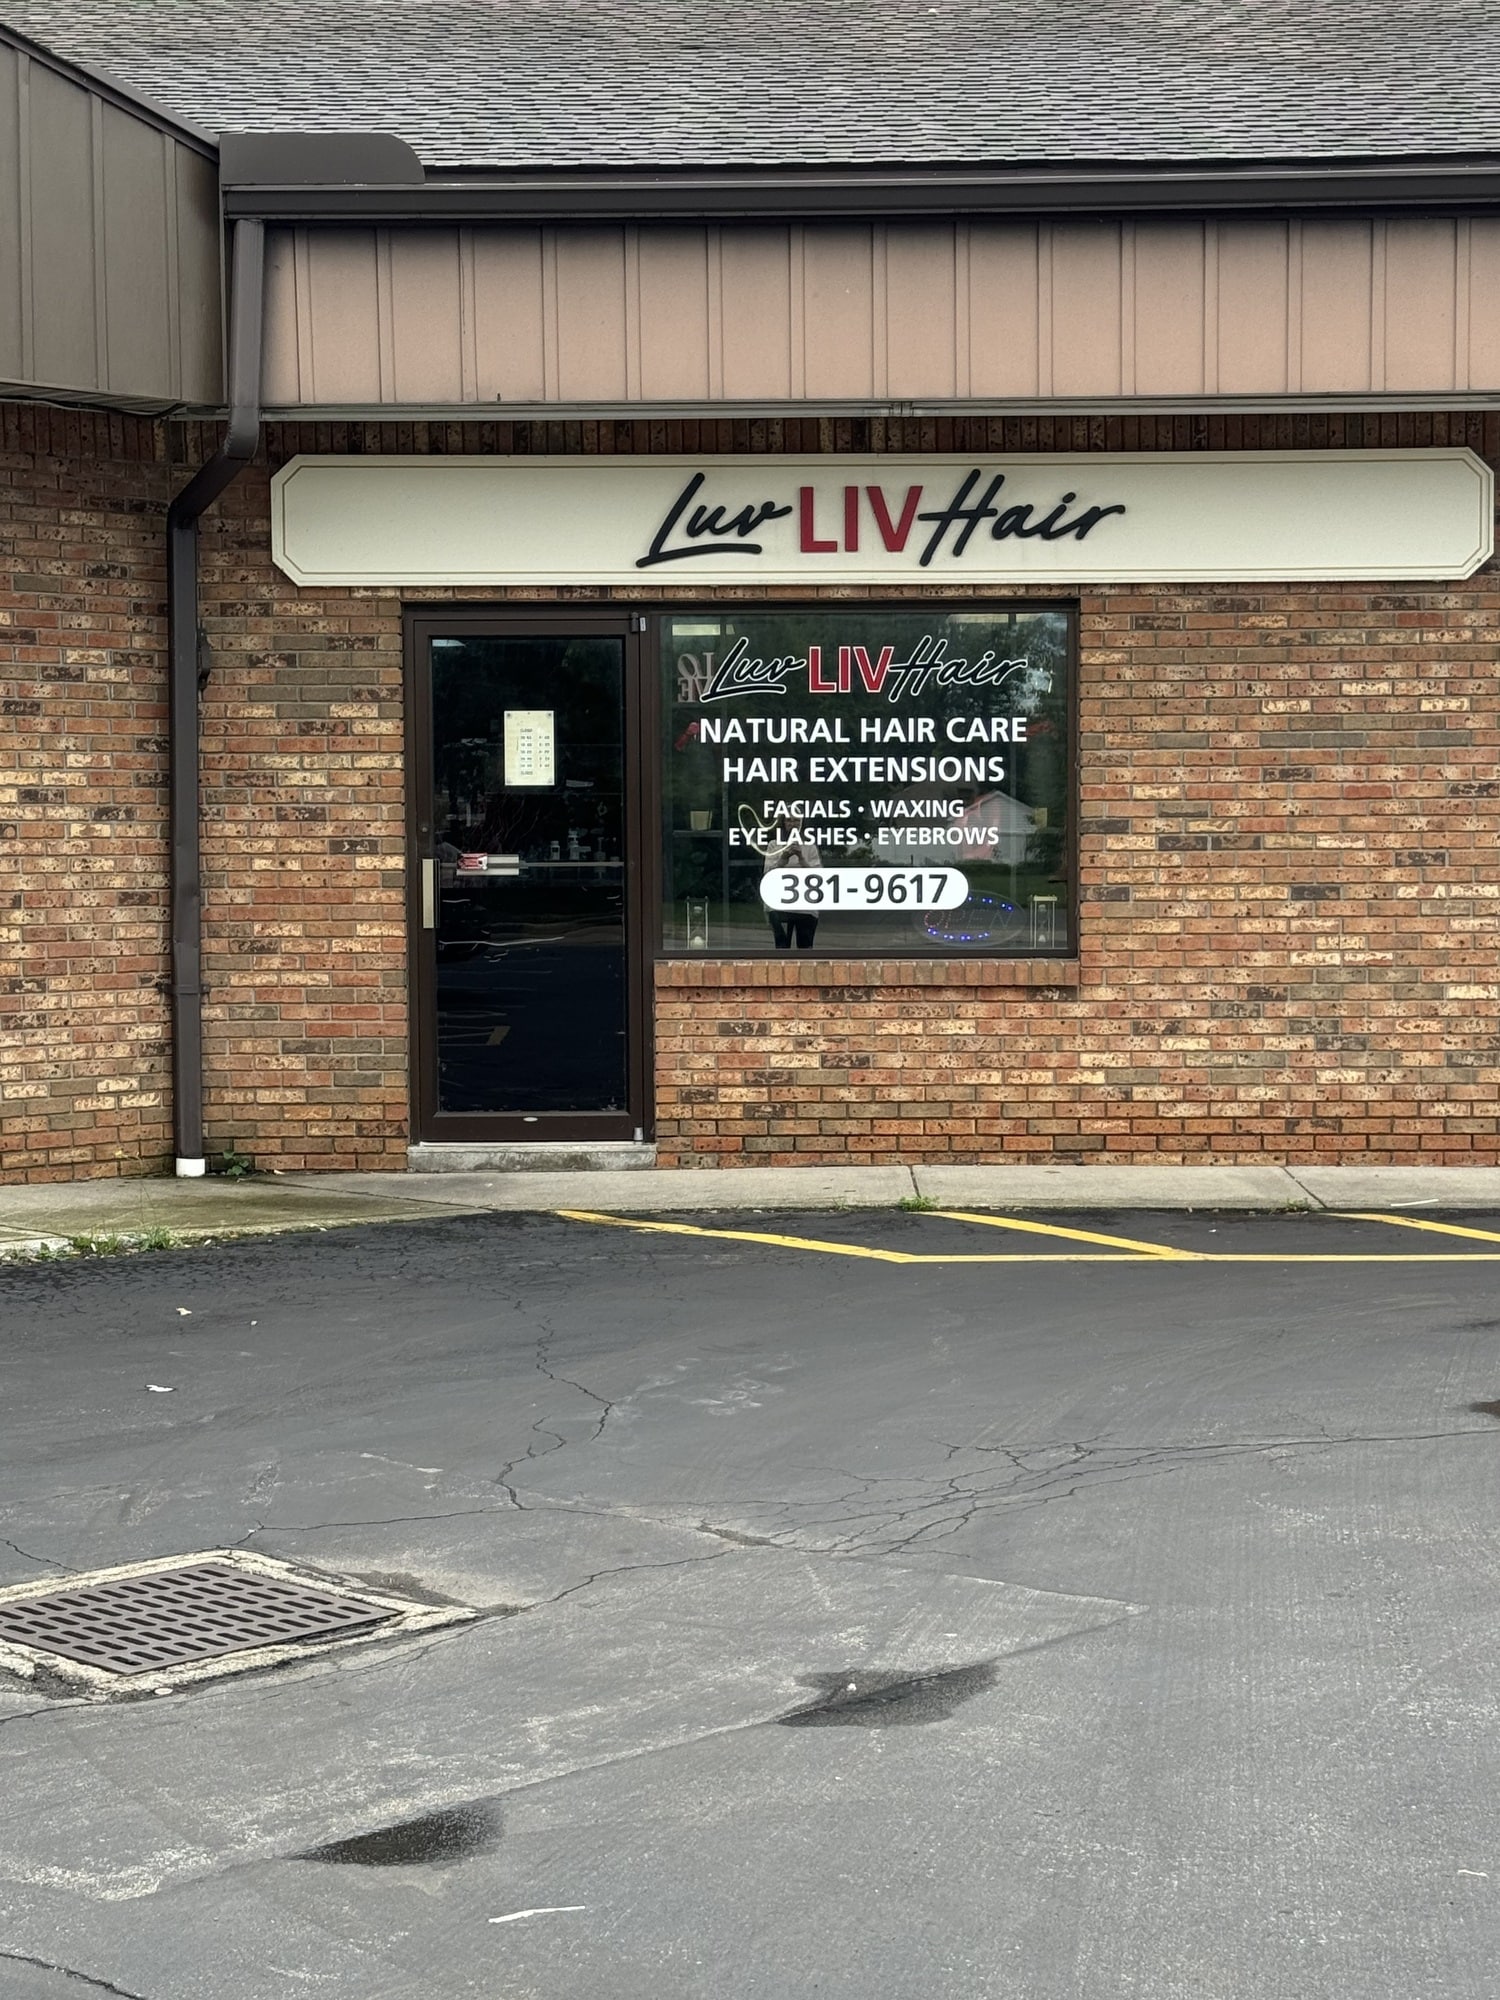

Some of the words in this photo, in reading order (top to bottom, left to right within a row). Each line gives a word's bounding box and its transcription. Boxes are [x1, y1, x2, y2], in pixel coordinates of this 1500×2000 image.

[635, 472, 793, 568] Luv
[800, 485, 924, 552] LIV
[917, 468, 1126, 567] Hair
[700, 636, 807, 702] Luv
[808, 646, 895, 693] LIV
[888, 635, 1028, 702] Hair
[701, 718, 849, 743] NATURAL
[861, 718, 935, 742] HAIR
[946, 717, 1027, 743] CARE
[723, 758, 797, 783] HAIR
[810, 757, 1004, 782] EXTENSIONS
[763, 800, 851, 818] FACIALS
[870, 800, 964, 818] WAXING
[729, 827, 768, 845] EYE
[776, 827, 857, 845] LASHES
[878, 827, 999, 845] EYEBROWS
[780, 874, 948, 904] 381-9617
